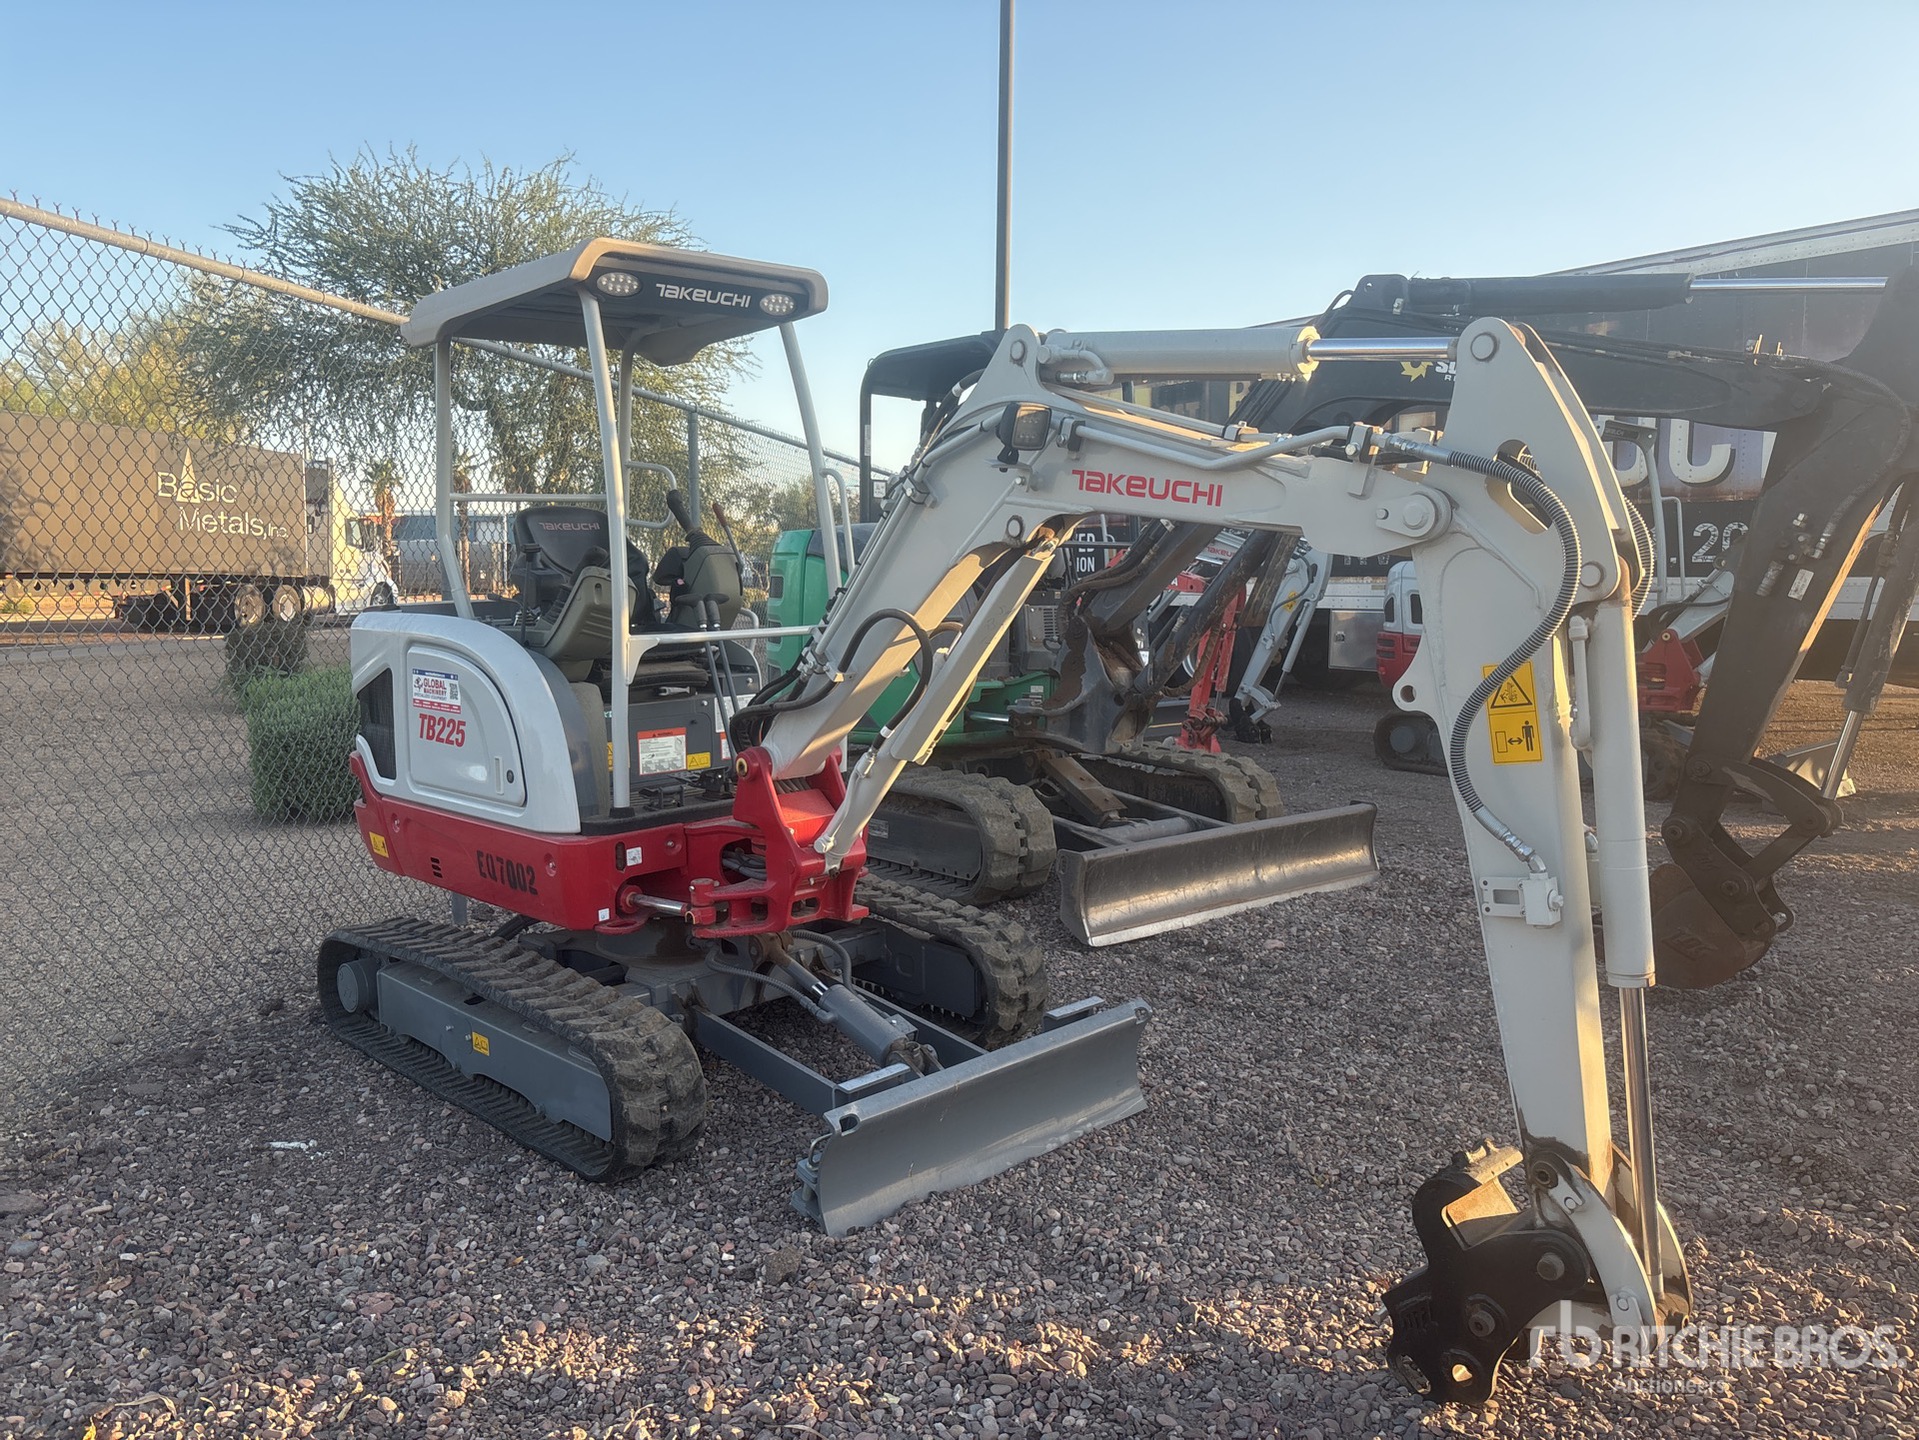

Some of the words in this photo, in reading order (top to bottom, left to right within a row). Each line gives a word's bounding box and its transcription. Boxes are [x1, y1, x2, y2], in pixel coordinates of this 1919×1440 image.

[157, 471, 238, 503] Basic
[423, 678, 447, 690] GLOBAL
[419, 713, 466, 748] TB225
